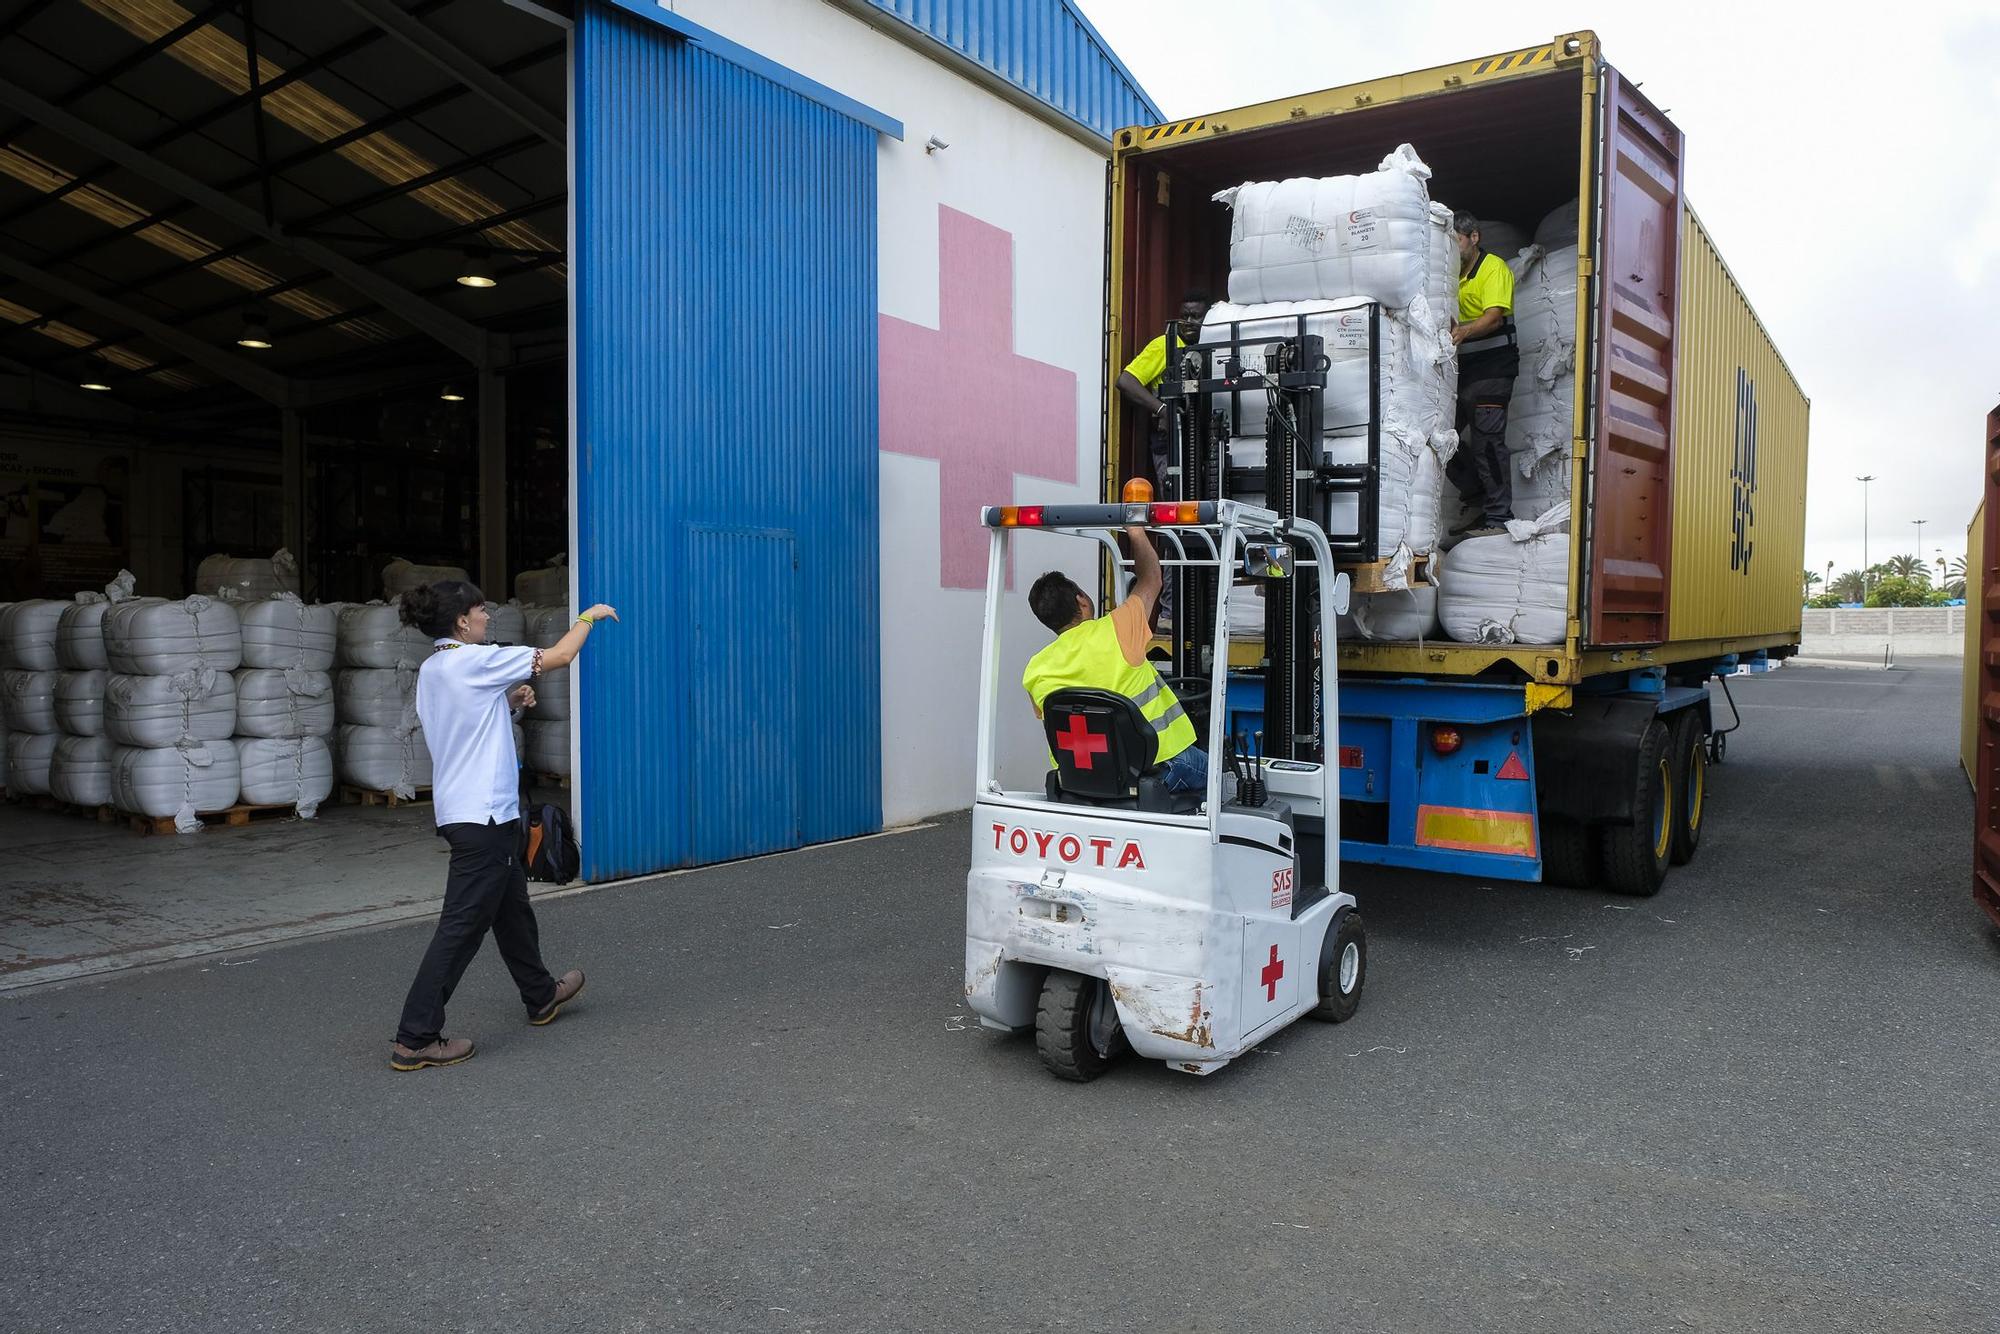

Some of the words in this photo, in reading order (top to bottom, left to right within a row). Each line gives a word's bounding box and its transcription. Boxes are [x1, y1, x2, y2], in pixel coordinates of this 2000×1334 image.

[1313, 665, 1321, 750] TOYOTA
[991, 822, 1147, 870] TOYOTA
[1272, 869, 1292, 893] SAS
